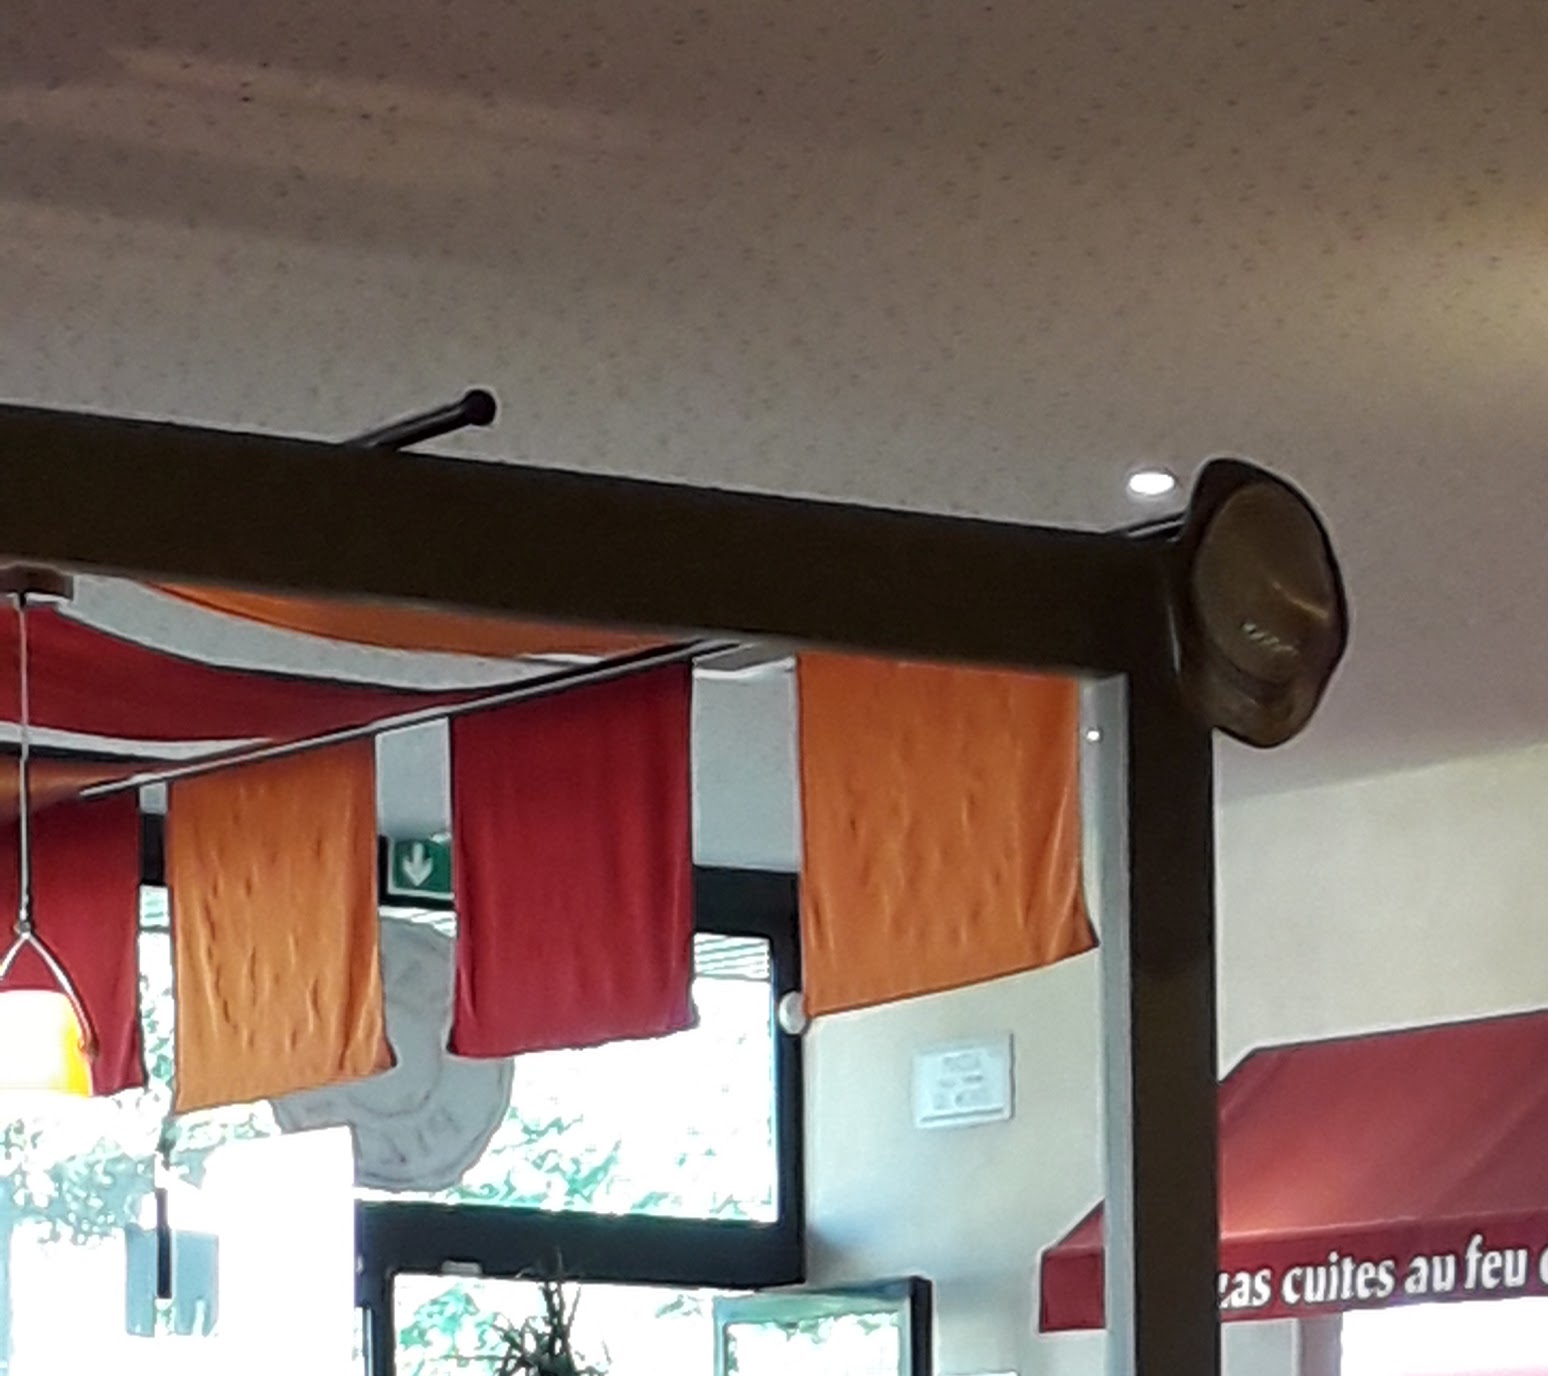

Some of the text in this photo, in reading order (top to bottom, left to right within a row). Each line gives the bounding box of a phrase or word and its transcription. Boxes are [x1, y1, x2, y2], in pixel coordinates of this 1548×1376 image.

[1280, 1251, 1397, 1304] cuites
[1403, 1254, 1455, 1294] au
[1463, 1233, 1527, 1290] feu
